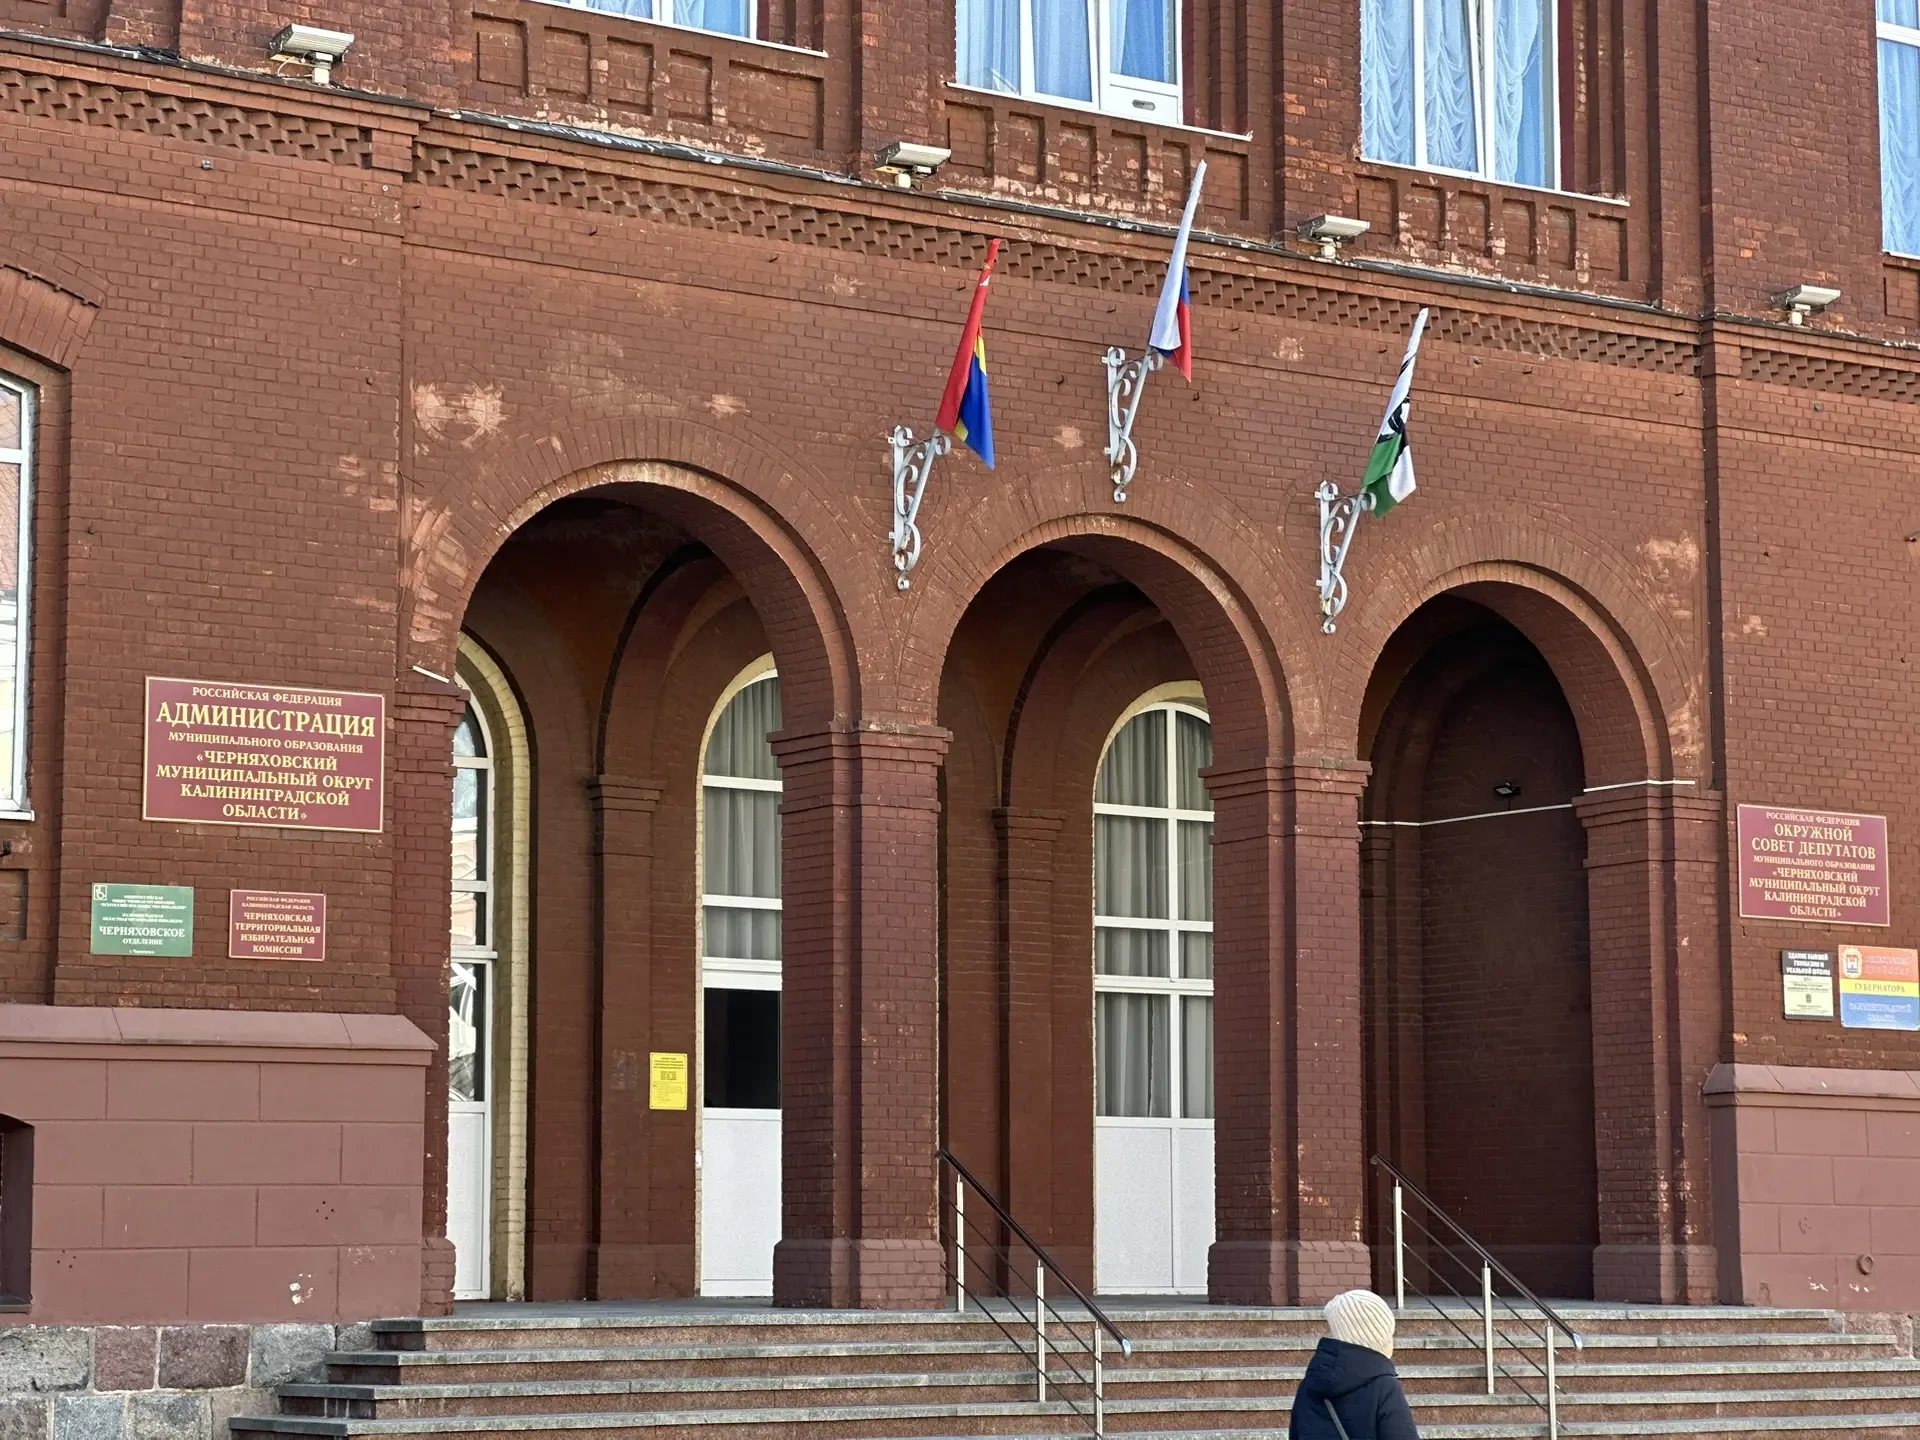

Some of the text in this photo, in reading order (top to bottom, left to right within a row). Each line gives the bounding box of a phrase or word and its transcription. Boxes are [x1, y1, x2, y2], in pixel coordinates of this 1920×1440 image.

[192, 686, 342, 707] РОССИЙСКАЯ ФЕДЕРАЦИЯ
[156, 702, 376, 738] АДМИНИСТРАЦИЯ
[168, 732, 363, 754] МУНИЦИПАЛЬНОГО ОБРАЗОВАНИЯ
[196, 750, 338, 772] «ЧЕРНЯХОВСКИЙ
[156, 764, 374, 790] МУНИЦИПАЛЬНЫЙ ОКРУГ
[180, 784, 350, 806] КАЛИНИНГРАДСКОЙ
[222, 803, 308, 820] ОБЛАСТИ»
[1766, 812, 1860, 826] РОССИЙСКАЯ ФЕДЕРАЦИЯ
[1774, 823, 1853, 842] ОКРУЖНОЙ
[1752, 838, 1876, 860] СОВЕТ ДЕПУТАТОВ
[1753, 855, 1876, 872] МУНИЦИПАЛЬНОГО ОБРАЗОВАНИЯ
[1749, 877, 1880, 896] МУНИЦИПАЛЬНЫЙ ОКРУГ
[1764, 890, 1866, 908] КАЛИНИНГРАДСКОЙ
[244, 912, 313, 922] ЧЕРНЯХОВСКАЯ
[99, 926, 185, 938] ЧЕРНЯХОВСКОЕ
[234, 922, 320, 934] ТЕРРИТОРИАЛЬНАЯ
[240, 933, 315, 944] ИЗБИРАТЕЛЬНАЯ
[252, 945, 302, 954] КОМИССИЯ
[1854, 983, 1906, 993] ГУБЕРНАТОРА
